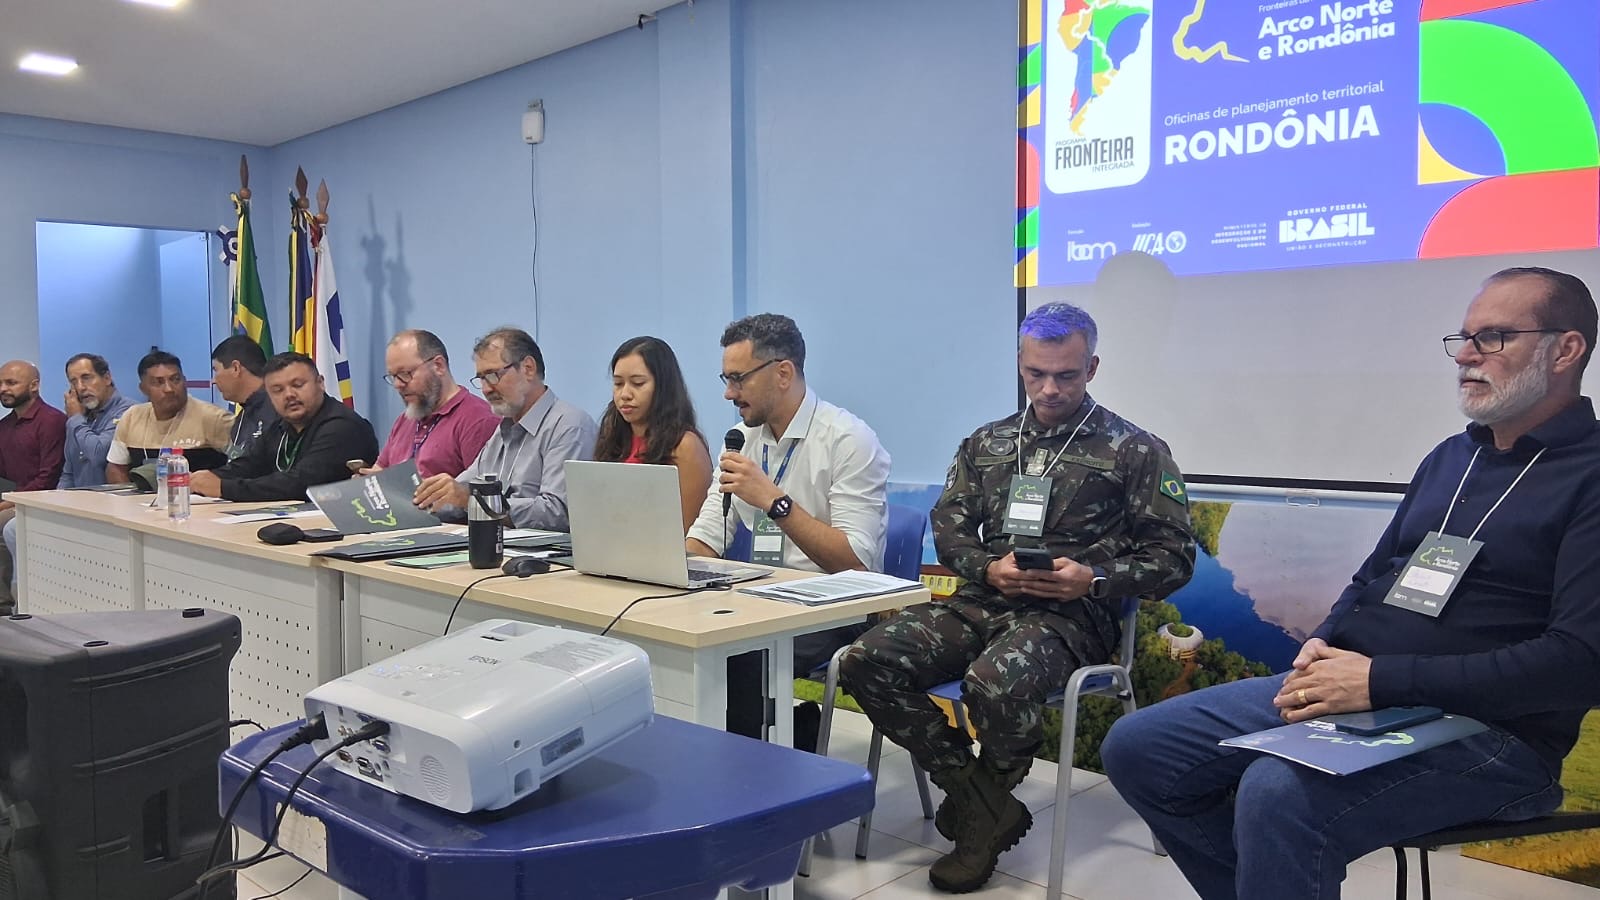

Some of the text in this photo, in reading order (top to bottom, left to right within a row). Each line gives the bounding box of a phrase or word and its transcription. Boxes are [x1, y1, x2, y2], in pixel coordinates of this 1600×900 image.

[1258, 0, 1393, 39] Arco Norte
[1258, 17, 1395, 60] e Rondônia
[1164, 80, 1385, 126] Oficinas de planejamento territorial
[1164, 104, 1380, 166] RONDÔNIA
[1092, 160, 1135, 173] INTEGRADA
[1279, 212, 1375, 243] BRASIL
[1287, 202, 1368, 216] GOVERNO FEDERAL
